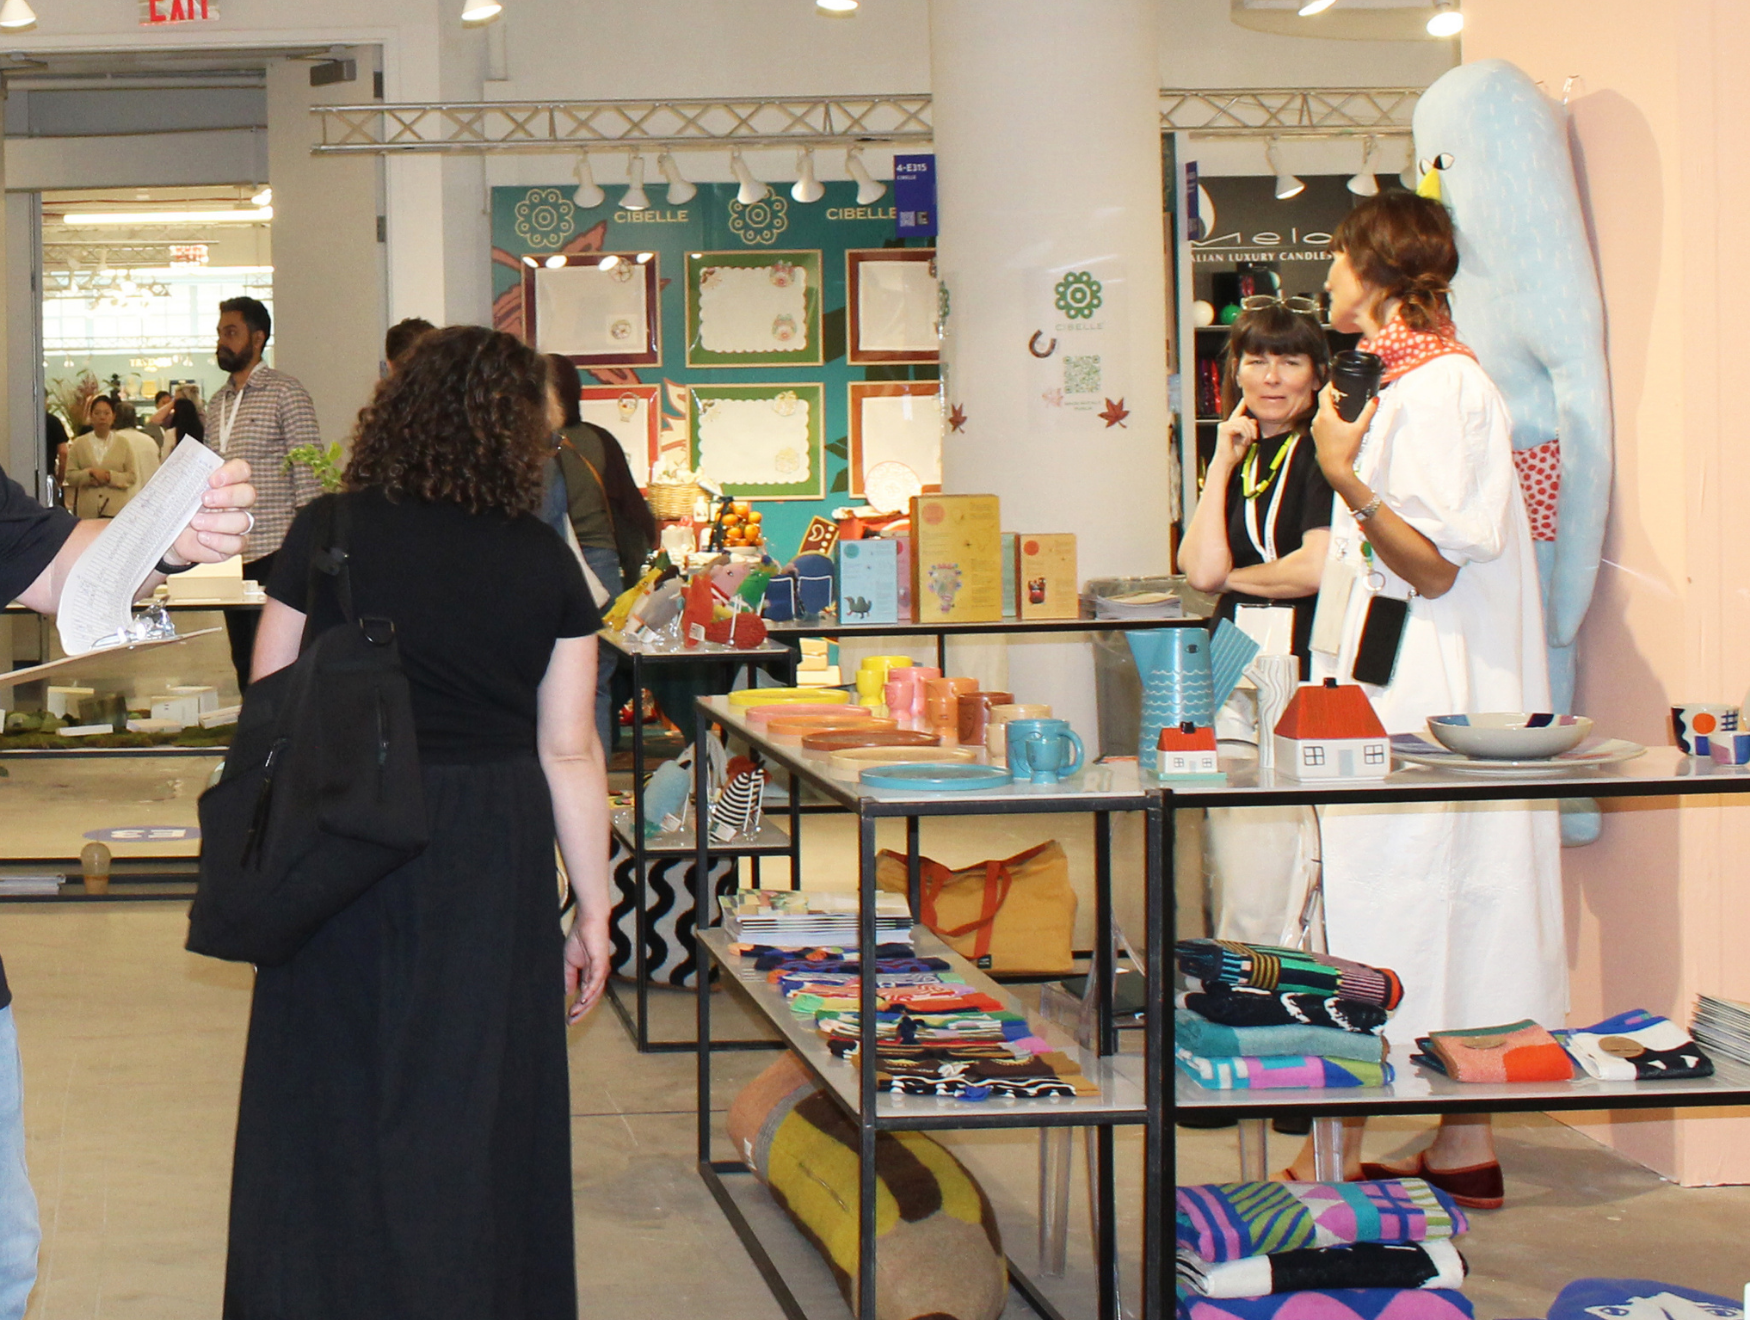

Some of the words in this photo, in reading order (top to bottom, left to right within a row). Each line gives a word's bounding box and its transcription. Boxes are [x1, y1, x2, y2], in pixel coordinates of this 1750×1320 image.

[896, 163, 927, 172] 4-E315
[614, 210, 689, 223] CIBELLE
[826, 207, 897, 220] CIBELLE
[1229, 252, 1275, 261] LUXURY
